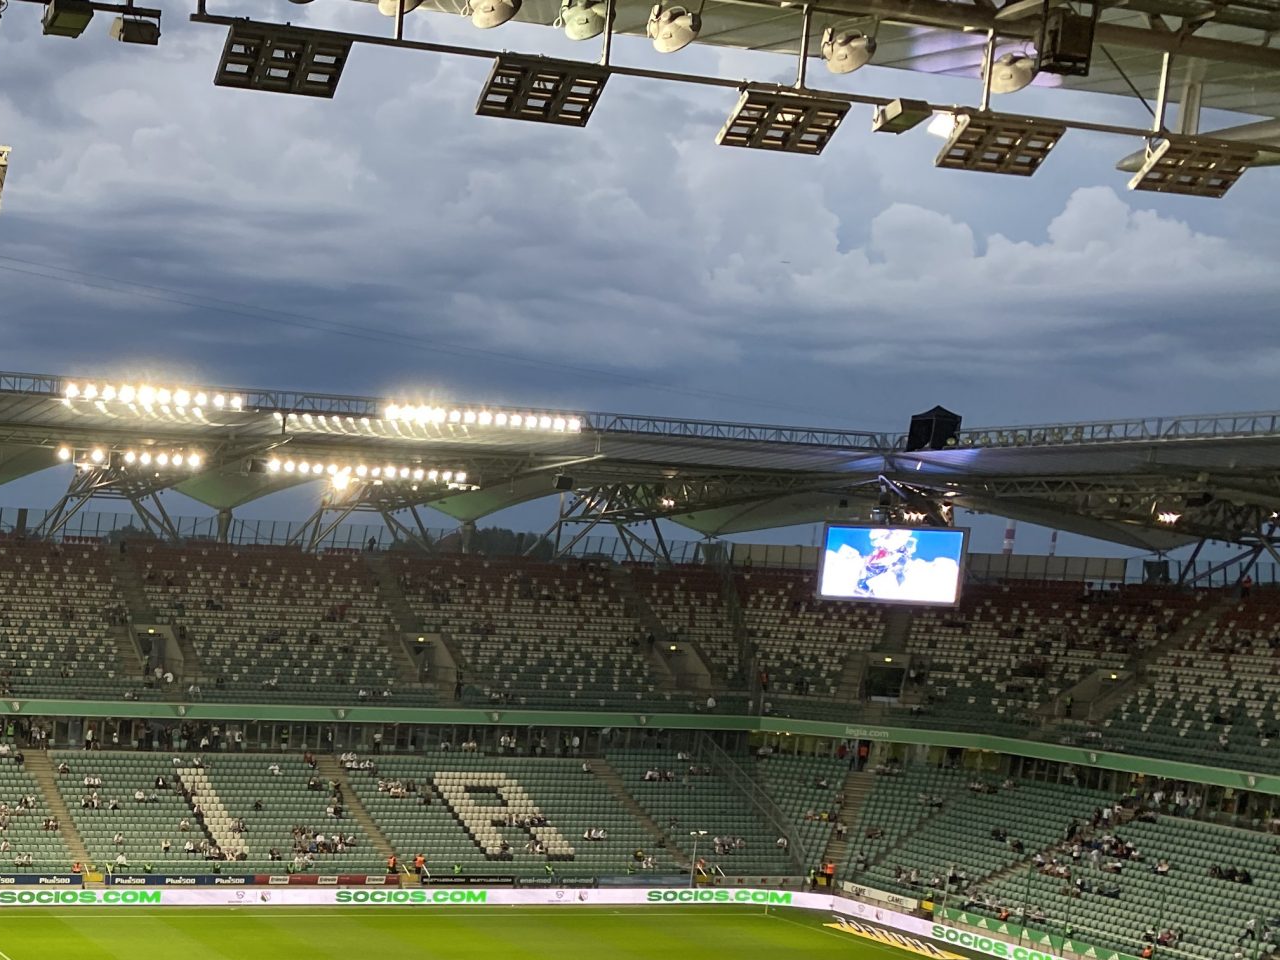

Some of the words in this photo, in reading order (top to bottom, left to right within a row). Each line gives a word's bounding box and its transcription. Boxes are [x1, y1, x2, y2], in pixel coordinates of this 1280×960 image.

[845, 725, 889, 738] legia.com
[39, 876, 70, 884] Plus500
[115, 876, 146, 885] Plus500
[165, 876, 196, 885] Plus500
[215, 876, 245, 885] Plus500
[851, 885, 866, 895] CAME
[335, 890, 488, 903] SOCIOS.COM
[647, 890, 793, 904] SOCIOS.COM
[887, 895, 904, 905] CAME
